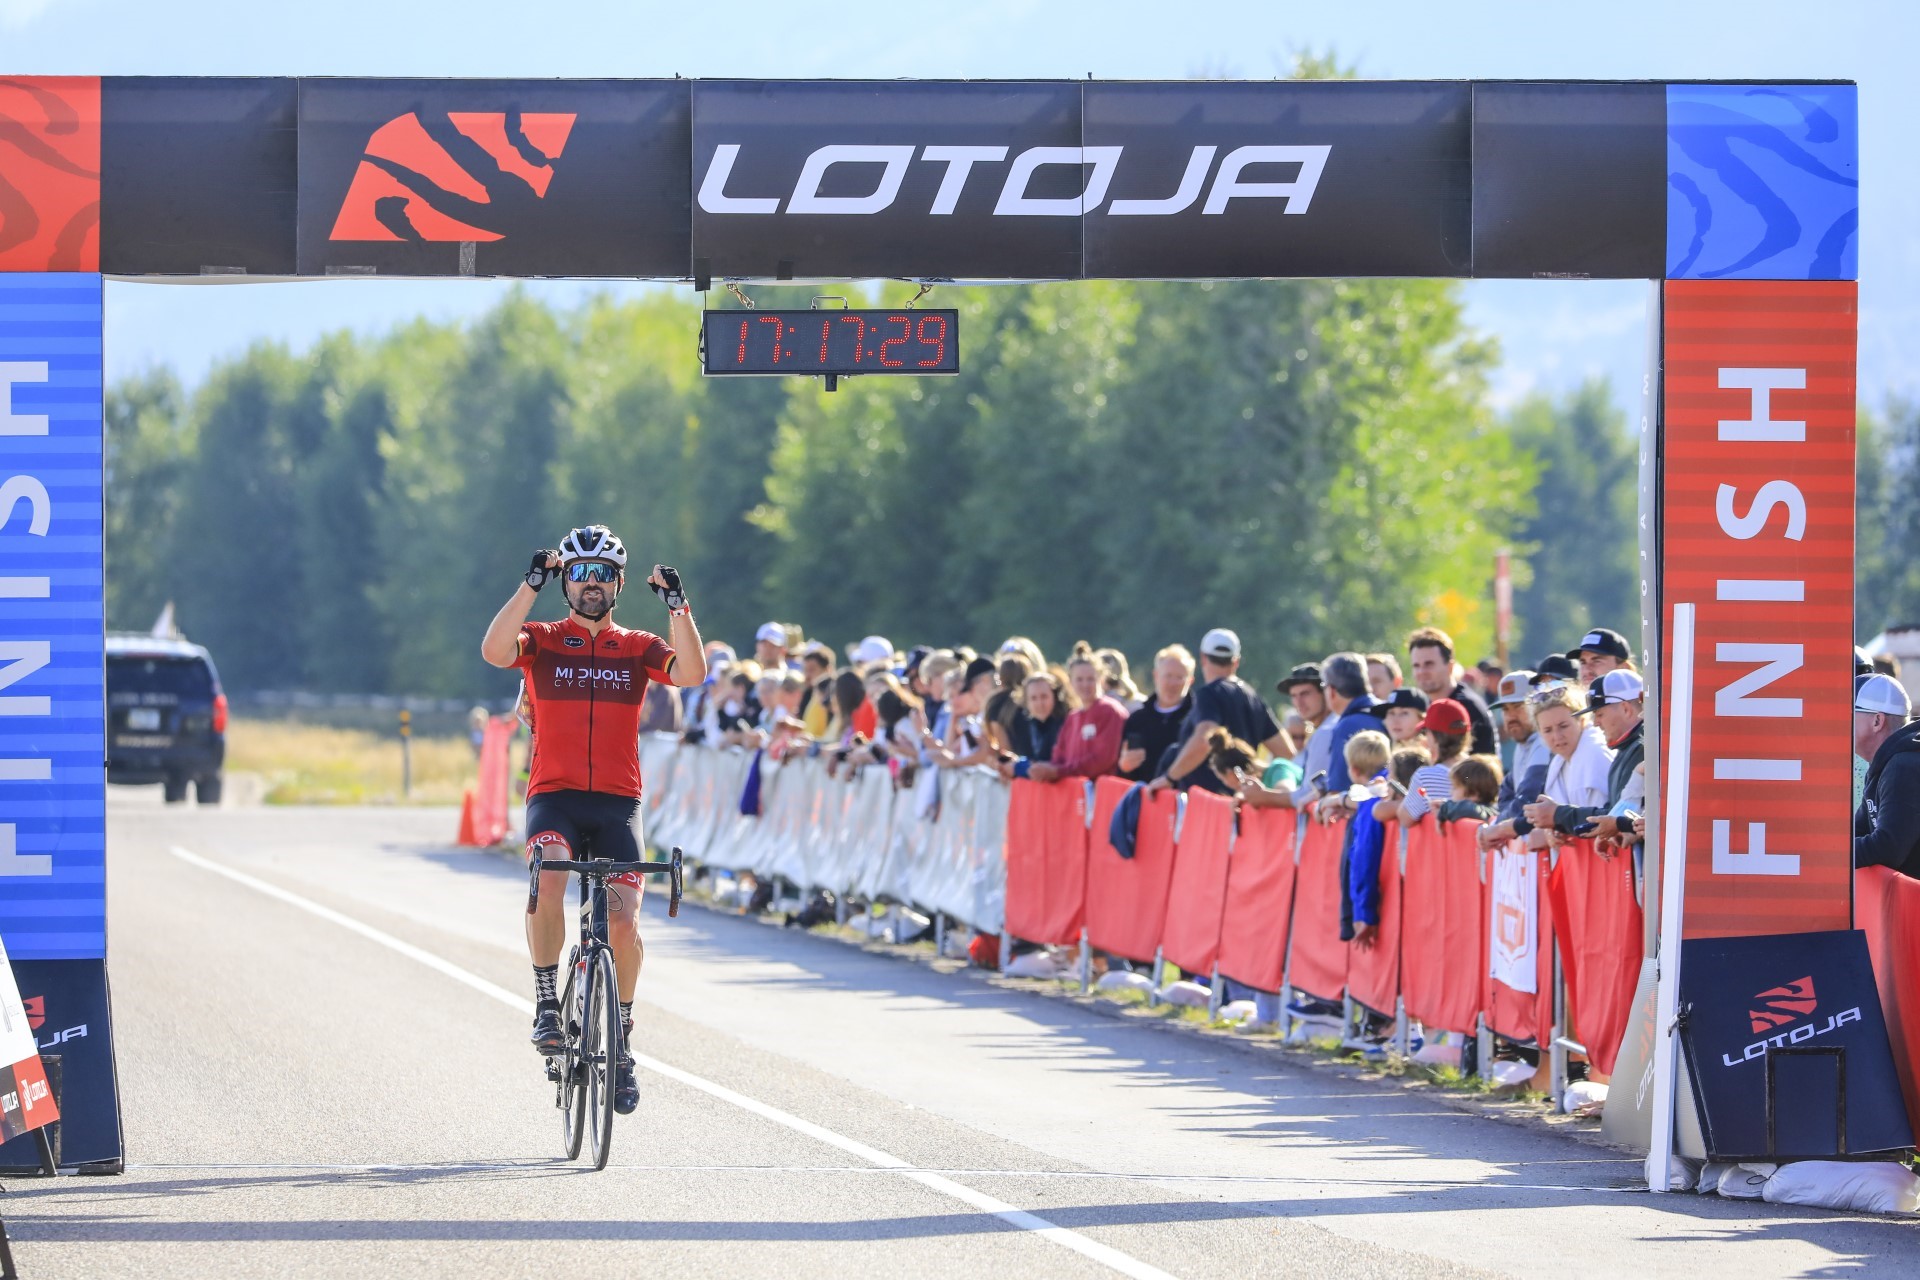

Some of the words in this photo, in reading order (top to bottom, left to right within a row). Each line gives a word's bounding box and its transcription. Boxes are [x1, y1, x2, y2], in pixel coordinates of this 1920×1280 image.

[697, 144, 1333, 216] LOTOJA
[737, 315, 947, 368] 17:17:29
[1712, 366, 1807, 877] FINISH
[554, 679, 631, 691] CYCLING
[555, 666, 574, 679] MI
[1722, 1007, 1862, 1067] LOTOJA
